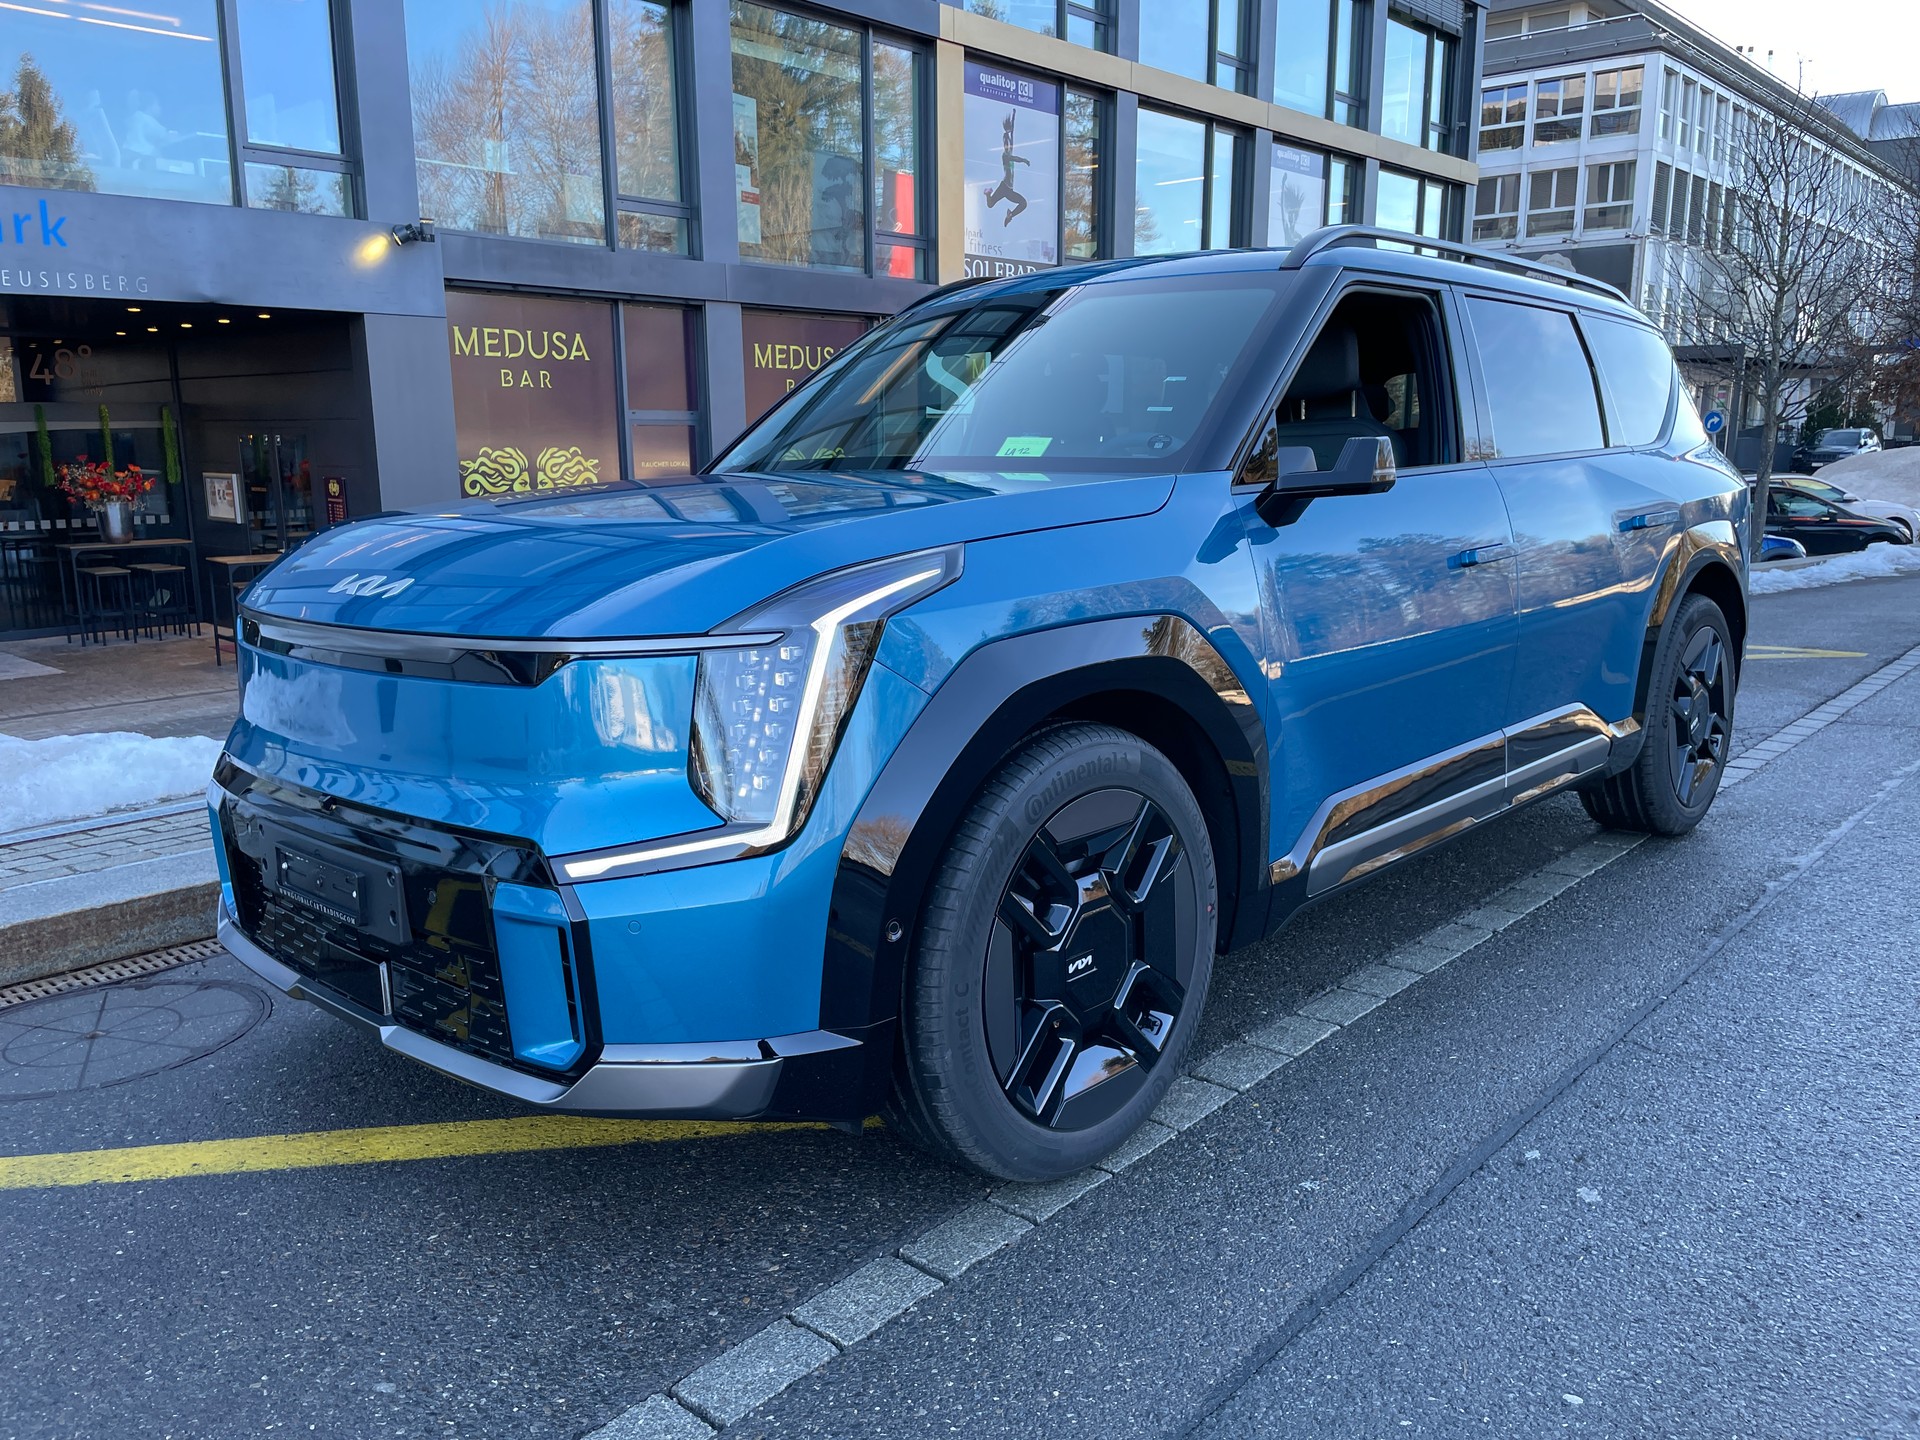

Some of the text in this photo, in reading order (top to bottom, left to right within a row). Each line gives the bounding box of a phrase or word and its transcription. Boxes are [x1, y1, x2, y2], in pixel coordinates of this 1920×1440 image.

[980, 73, 1016, 92] qualitop
[0, 199, 68, 247] rk
[969, 238, 1003, 256] fitness
[452, 325, 591, 361] MEDUSA
[753, 343, 844, 370] MEDUS
[500, 369, 553, 389] BAR
[1023, 751, 1118, 825] Continental
